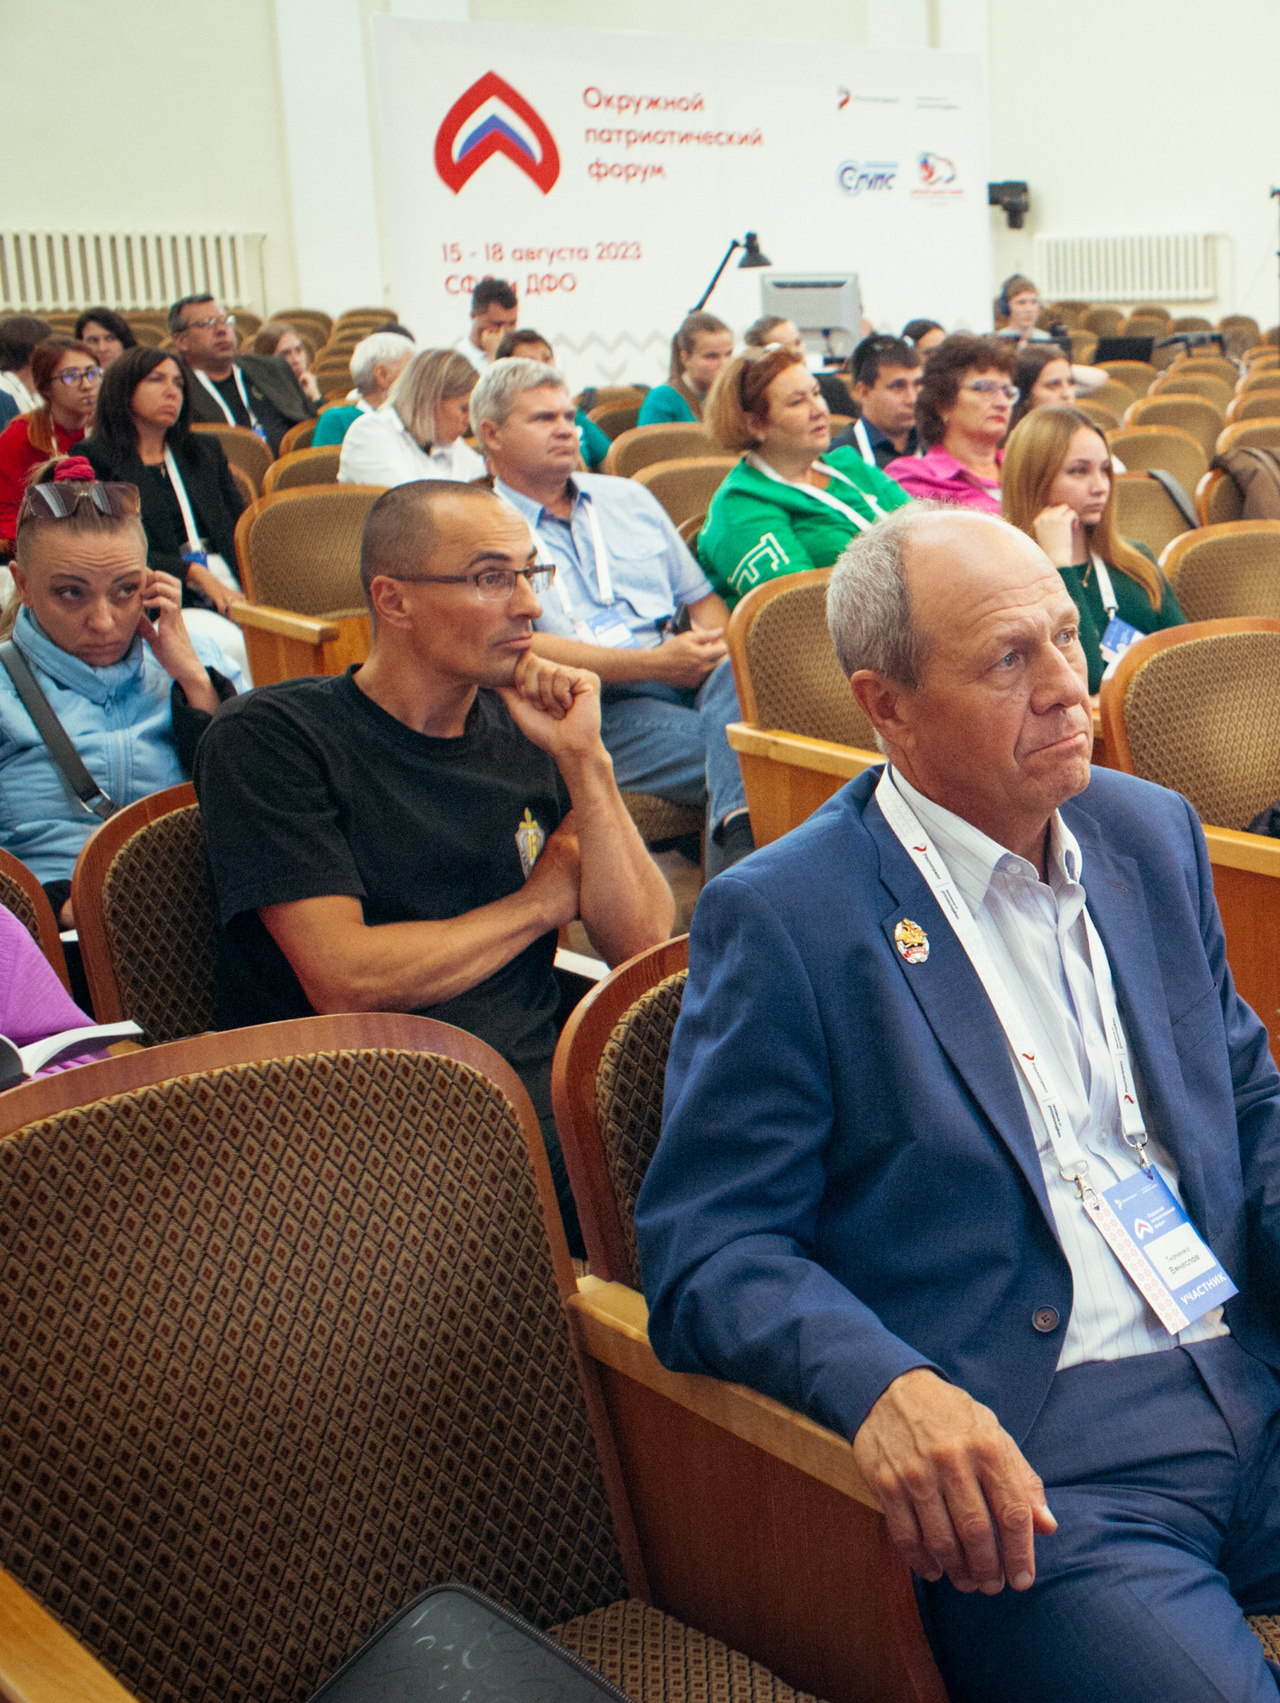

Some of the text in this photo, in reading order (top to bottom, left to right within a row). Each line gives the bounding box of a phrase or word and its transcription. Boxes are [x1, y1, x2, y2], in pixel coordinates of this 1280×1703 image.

[583, 86, 704, 115] Окружной
[585, 128, 762, 150] патриотический
[588, 157, 666, 184] форум
[442, 242, 462, 262] 15
[485, 242, 504, 262] 18
[511, 247, 589, 266] августа
[595, 241, 642, 261] 2023
[445, 273, 494, 295] СФ
[525, 272, 578, 296] ДФО
[1169, 1254, 1200, 1275] Вячеслав
[1180, 1271, 1227, 1305] УЧАСТНИК
